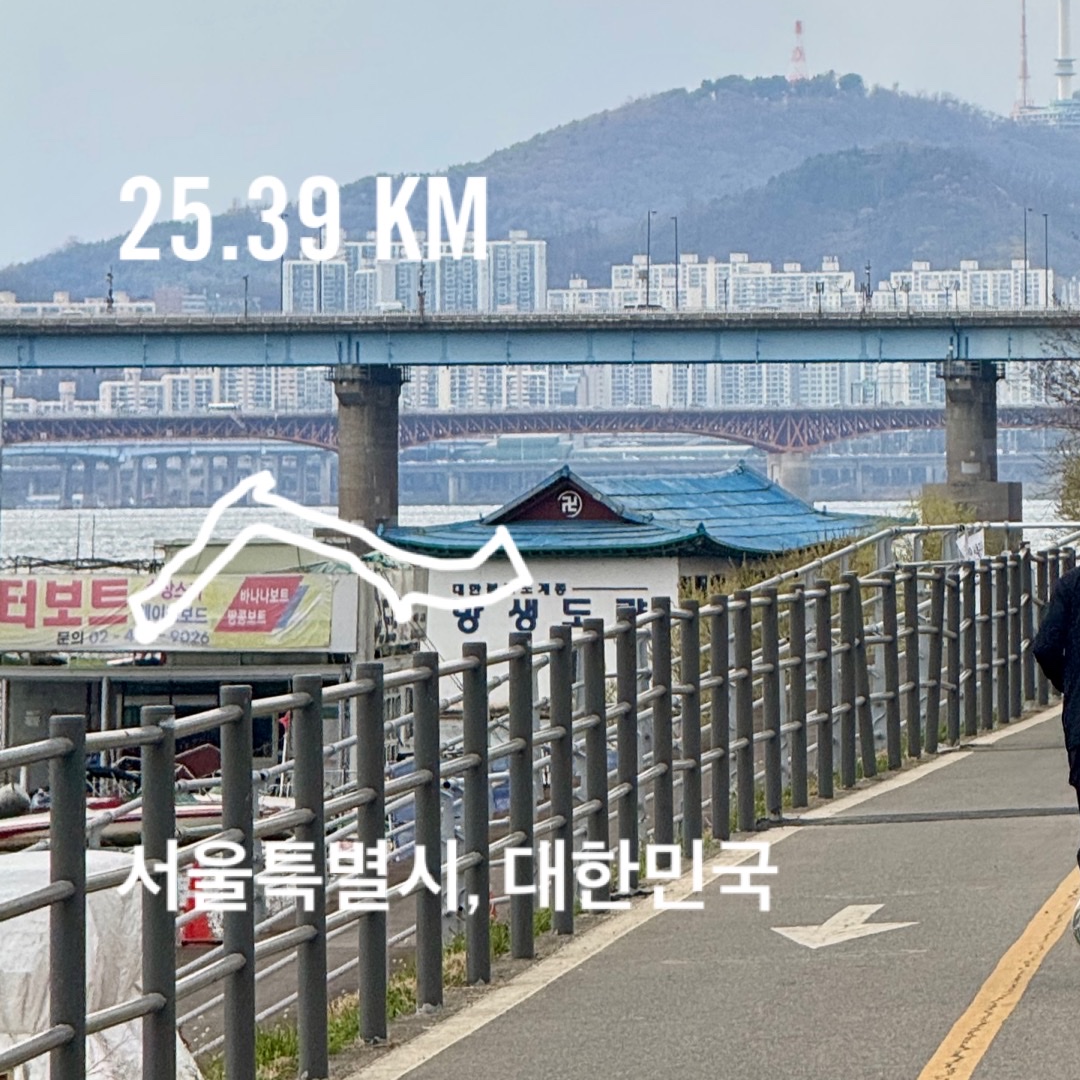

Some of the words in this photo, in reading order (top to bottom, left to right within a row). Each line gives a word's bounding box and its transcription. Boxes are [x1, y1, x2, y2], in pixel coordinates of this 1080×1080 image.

[0, 579, 128, 628] 터보트
[240, 587, 290, 604] 바나나보트
[57, 631, 84, 645] 문의
